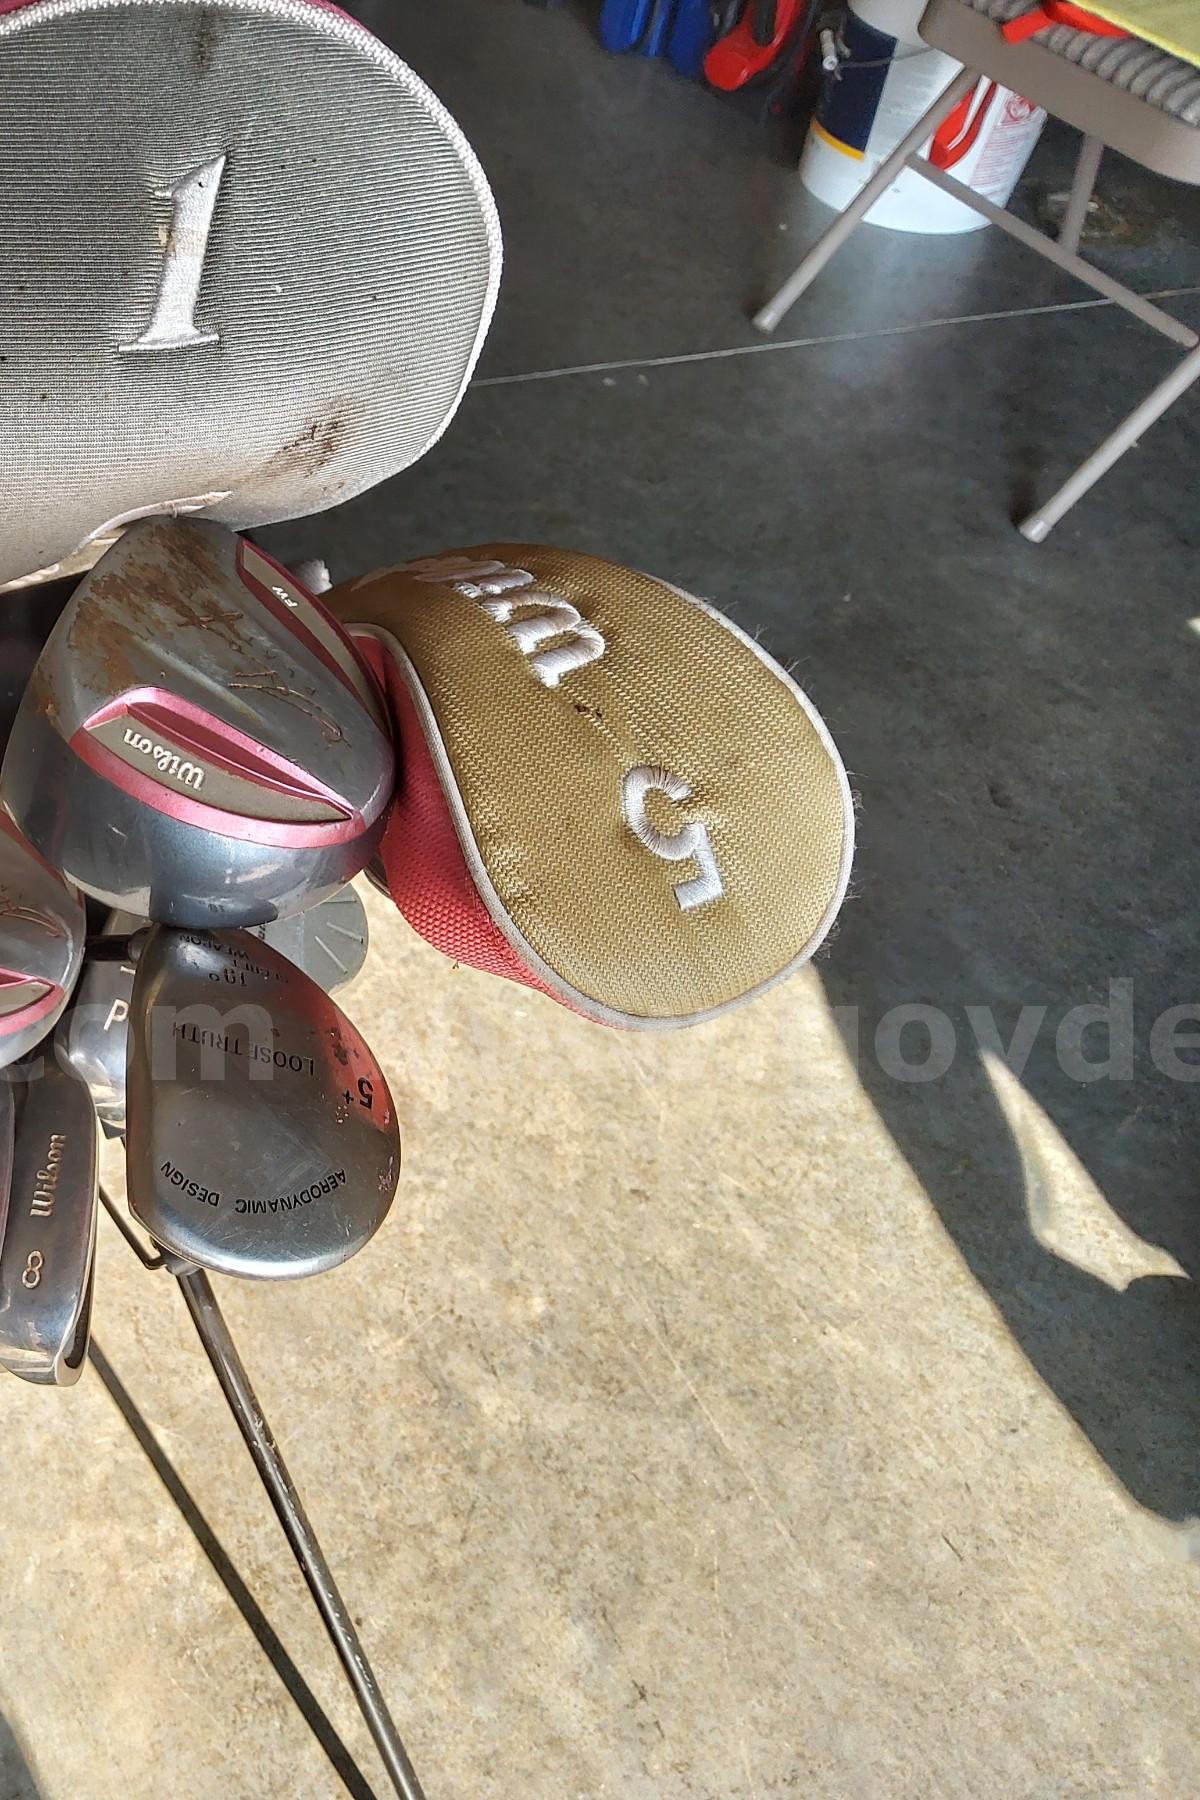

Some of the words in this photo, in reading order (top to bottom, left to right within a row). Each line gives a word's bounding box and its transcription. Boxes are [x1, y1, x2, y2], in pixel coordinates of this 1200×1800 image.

[118, 154, 227, 352] 1
[272, 585, 297, 609] FW
[123, 727, 206, 791] Wilson
[622, 764, 724, 912] 5
[103, 999, 130, 1031] P
[171, 1021, 242, 1057] TRUTH
[247, 1045, 315, 1077] LOOSE
[30, 1133, 66, 1218] Wilson
[160, 1160, 221, 1208] DESIGN
[234, 1168, 347, 1214] AERODYNAMIC
[21, 1250, 45, 1289] 8
